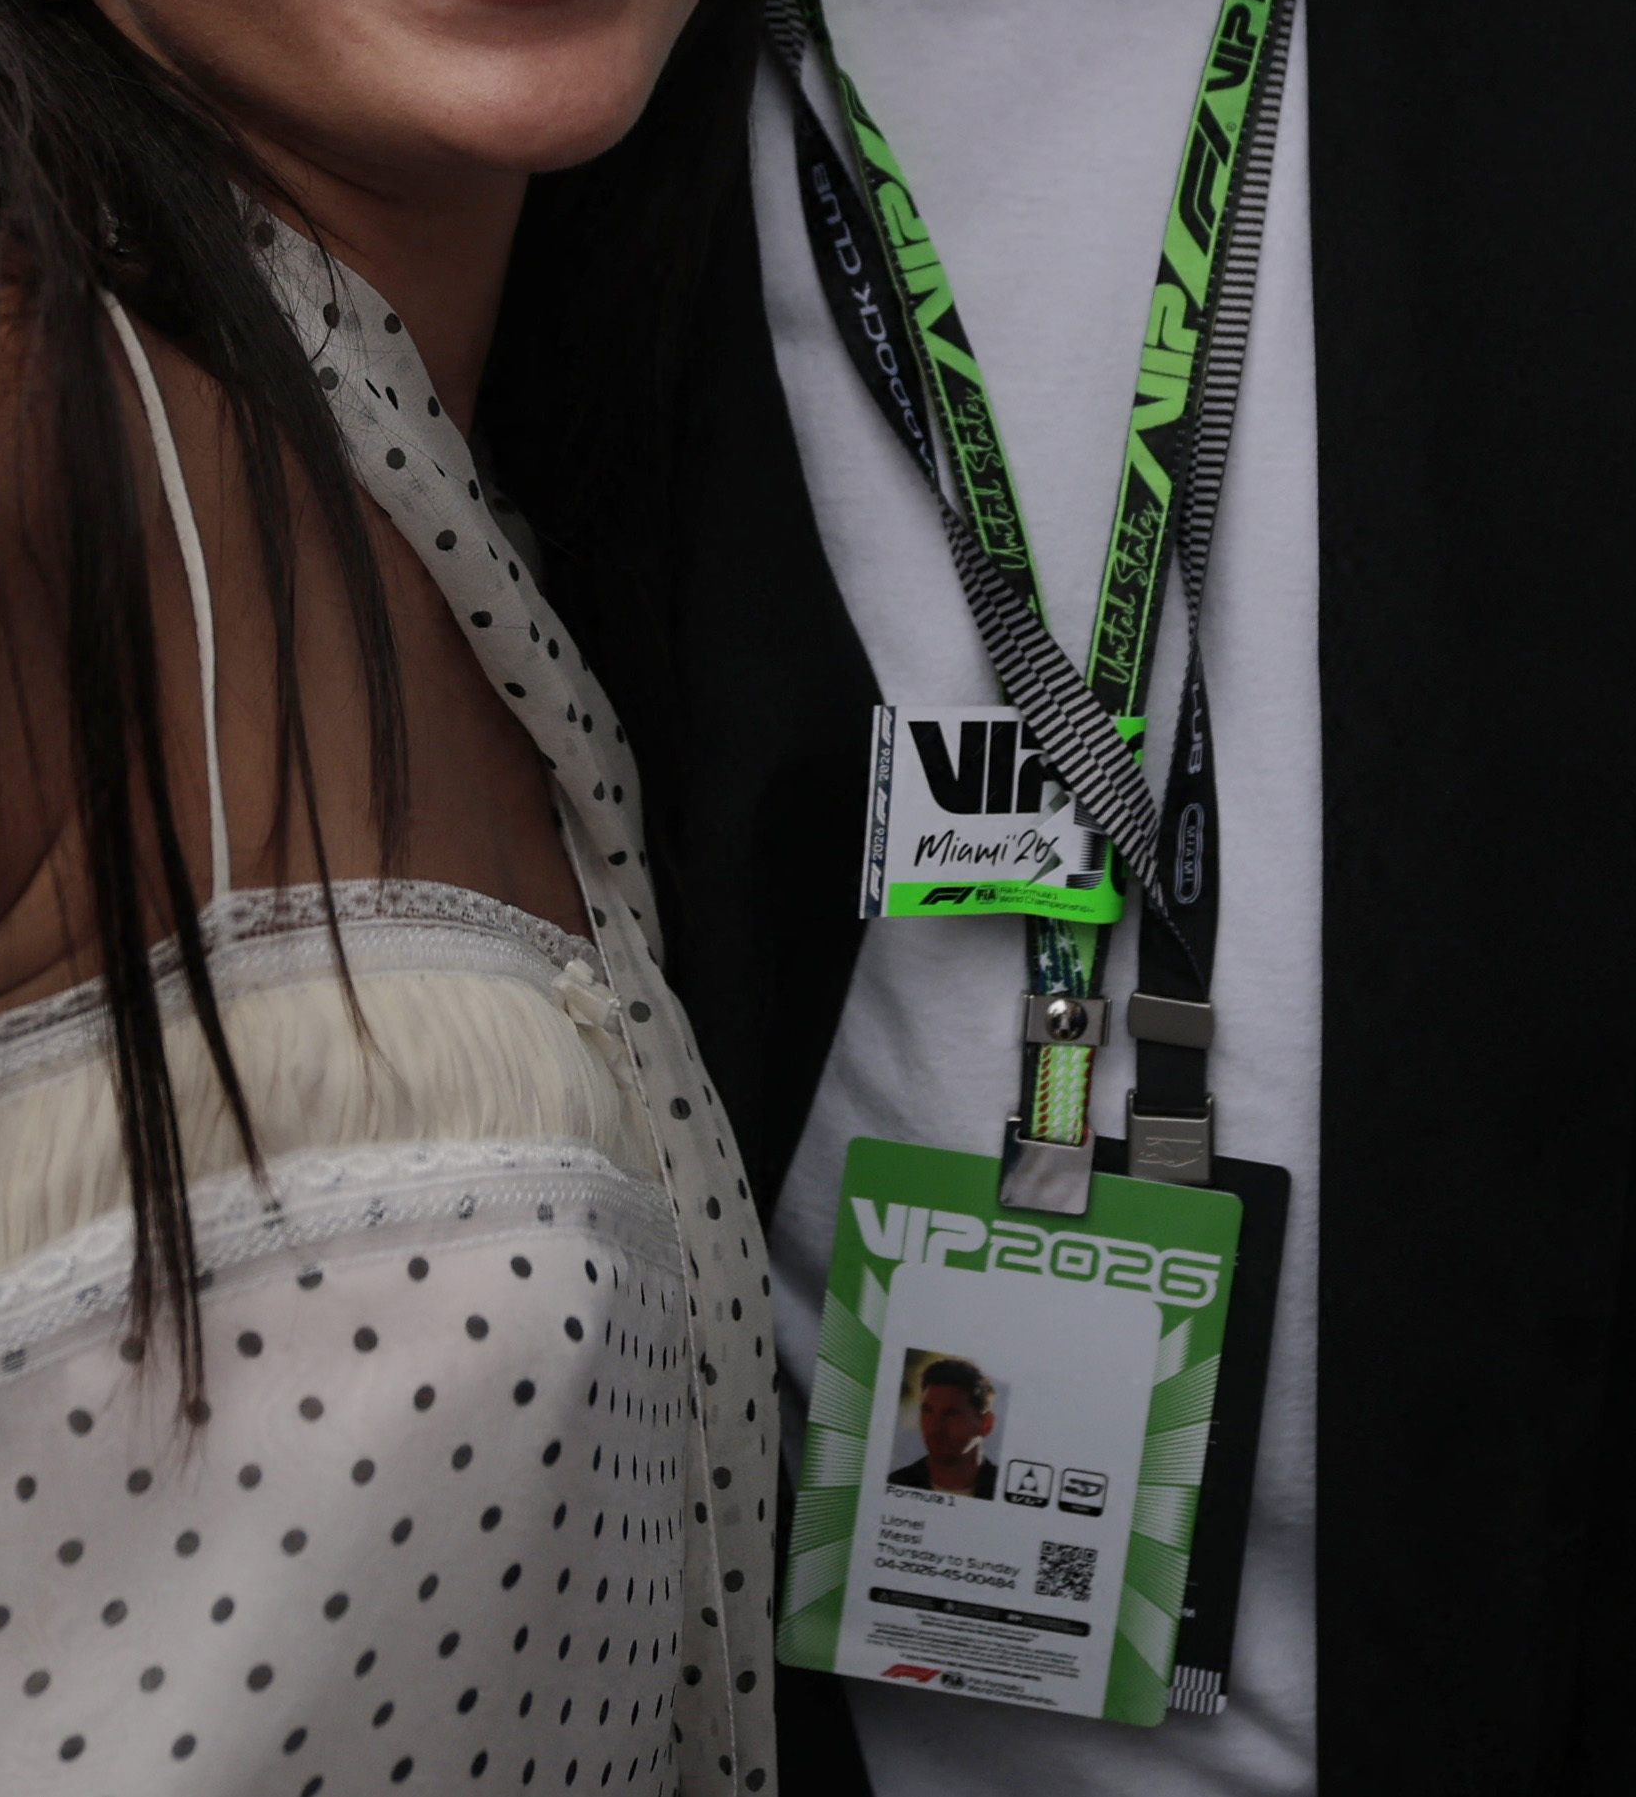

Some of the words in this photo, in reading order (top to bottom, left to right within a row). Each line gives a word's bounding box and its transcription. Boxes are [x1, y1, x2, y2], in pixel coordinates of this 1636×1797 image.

[1205, 2, 1256, 92] VIP
[811, 161, 863, 275] CLUB
[956, 388, 1003, 473] States
[975, 479, 1027, 569] United
[1114, 502, 1163, 588] States
[1101, 591, 1137, 686] United
[878, 748, 891, 782] 2026
[873, 826, 886, 860] 2026
[1183, 823, 1197, 884] MIAMI
[880, 1513, 925, 1530] Lionel
[886, 1485, 946, 1505] Formula
[948, 1495, 956, 1507] 1
[877, 1541, 944, 1565] Thursday
[947, 1555, 963, 1566] to
[967, 1557, 1021, 1577] Sunday
[880, 1529, 923, 1544] Messi
